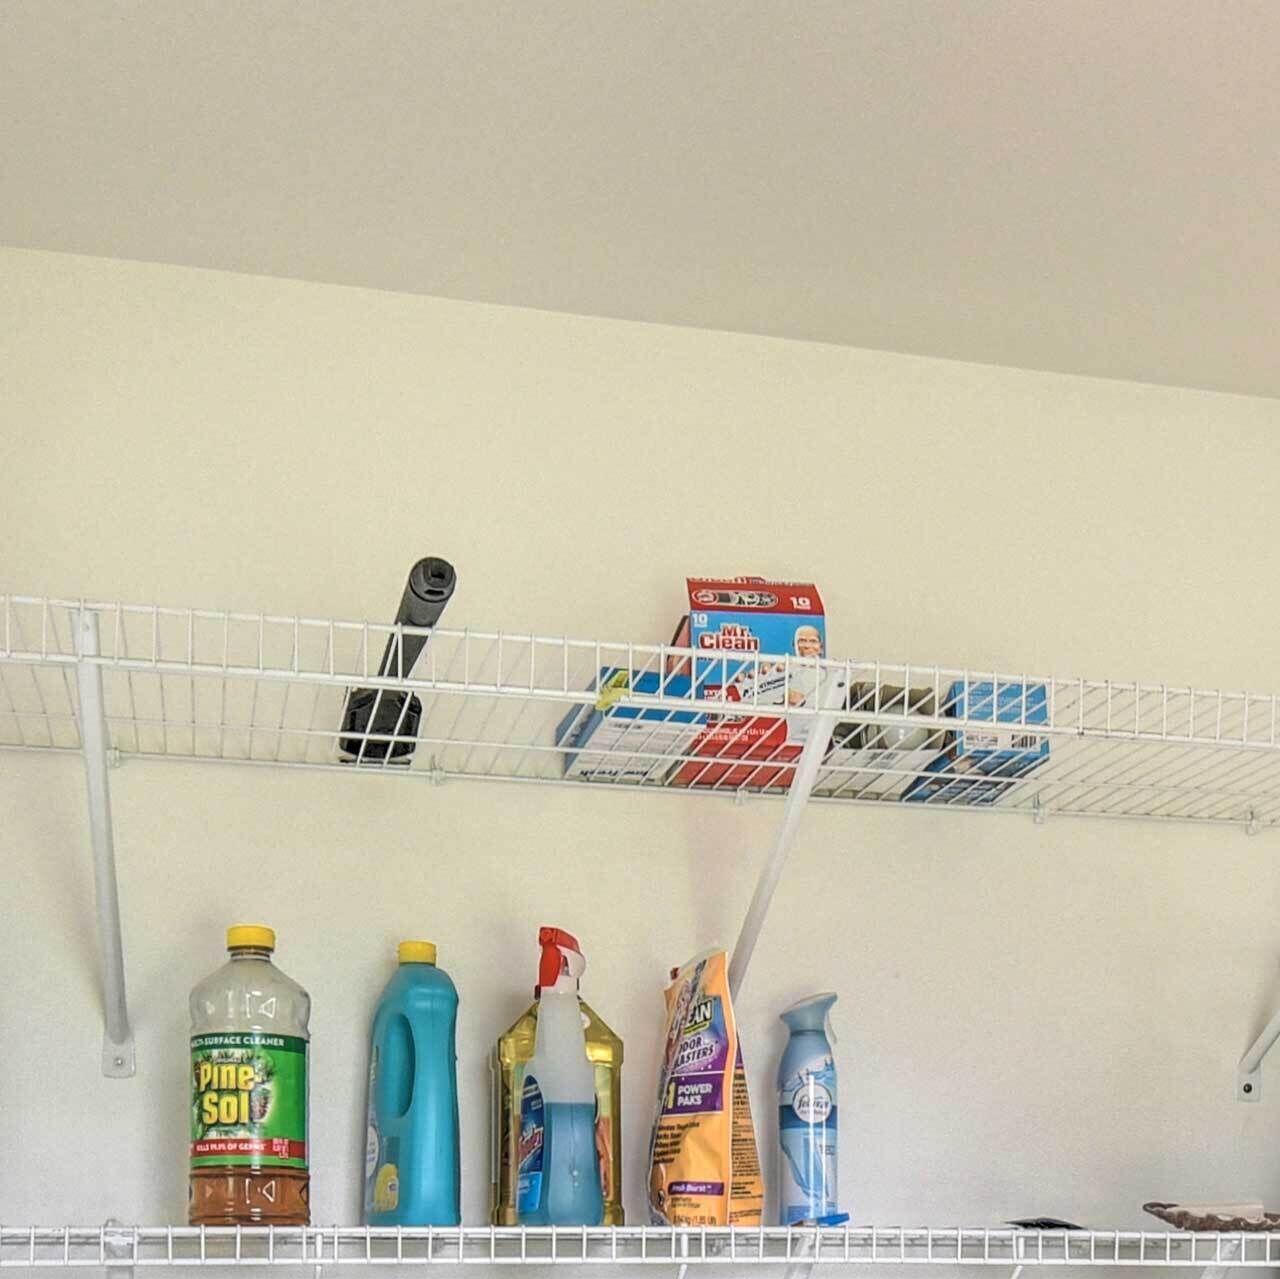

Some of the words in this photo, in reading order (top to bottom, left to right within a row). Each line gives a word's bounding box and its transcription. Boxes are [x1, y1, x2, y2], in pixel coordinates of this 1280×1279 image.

[790, 596, 812, 606] 10
[692, 613, 708, 624] 10
[722, 623, 753, 638] Mr.
[699, 632, 760, 651] Clean
[243, 1037, 285, 1047] CLEANER
[677, 1083, 713, 1095] POWER
[677, 1094, 703, 1106] PAKS
[202, 1090, 250, 1125] Sol
[227, 1143, 238, 1151] OF
